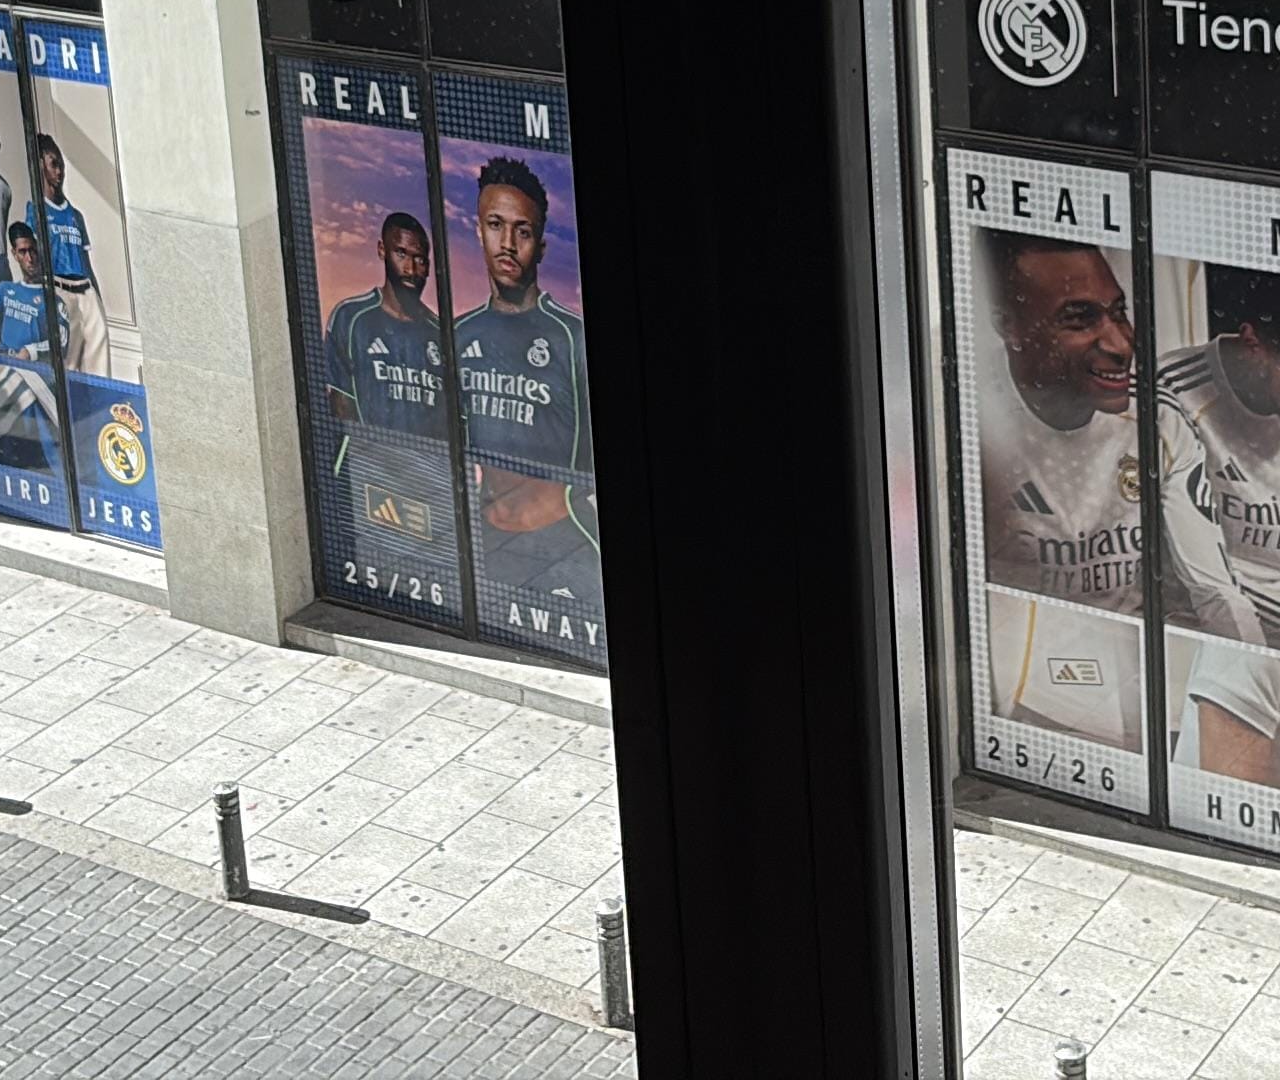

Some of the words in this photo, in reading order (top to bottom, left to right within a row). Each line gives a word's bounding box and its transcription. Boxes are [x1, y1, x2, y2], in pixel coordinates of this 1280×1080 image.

[299, 71, 417, 120] REAL
[965, 173, 1120, 232] REAL
[373, 360, 443, 391] Emirates
[459, 367, 551, 405] Emirates
[490, 397, 535, 426] BETTER
[88, 497, 153, 532] JERS
[1241, 526, 1273, 548] FLY
[344, 561, 443, 606] 25/26
[508, 602, 599, 646] AWAY
[987, 736, 1116, 792] 25/26
